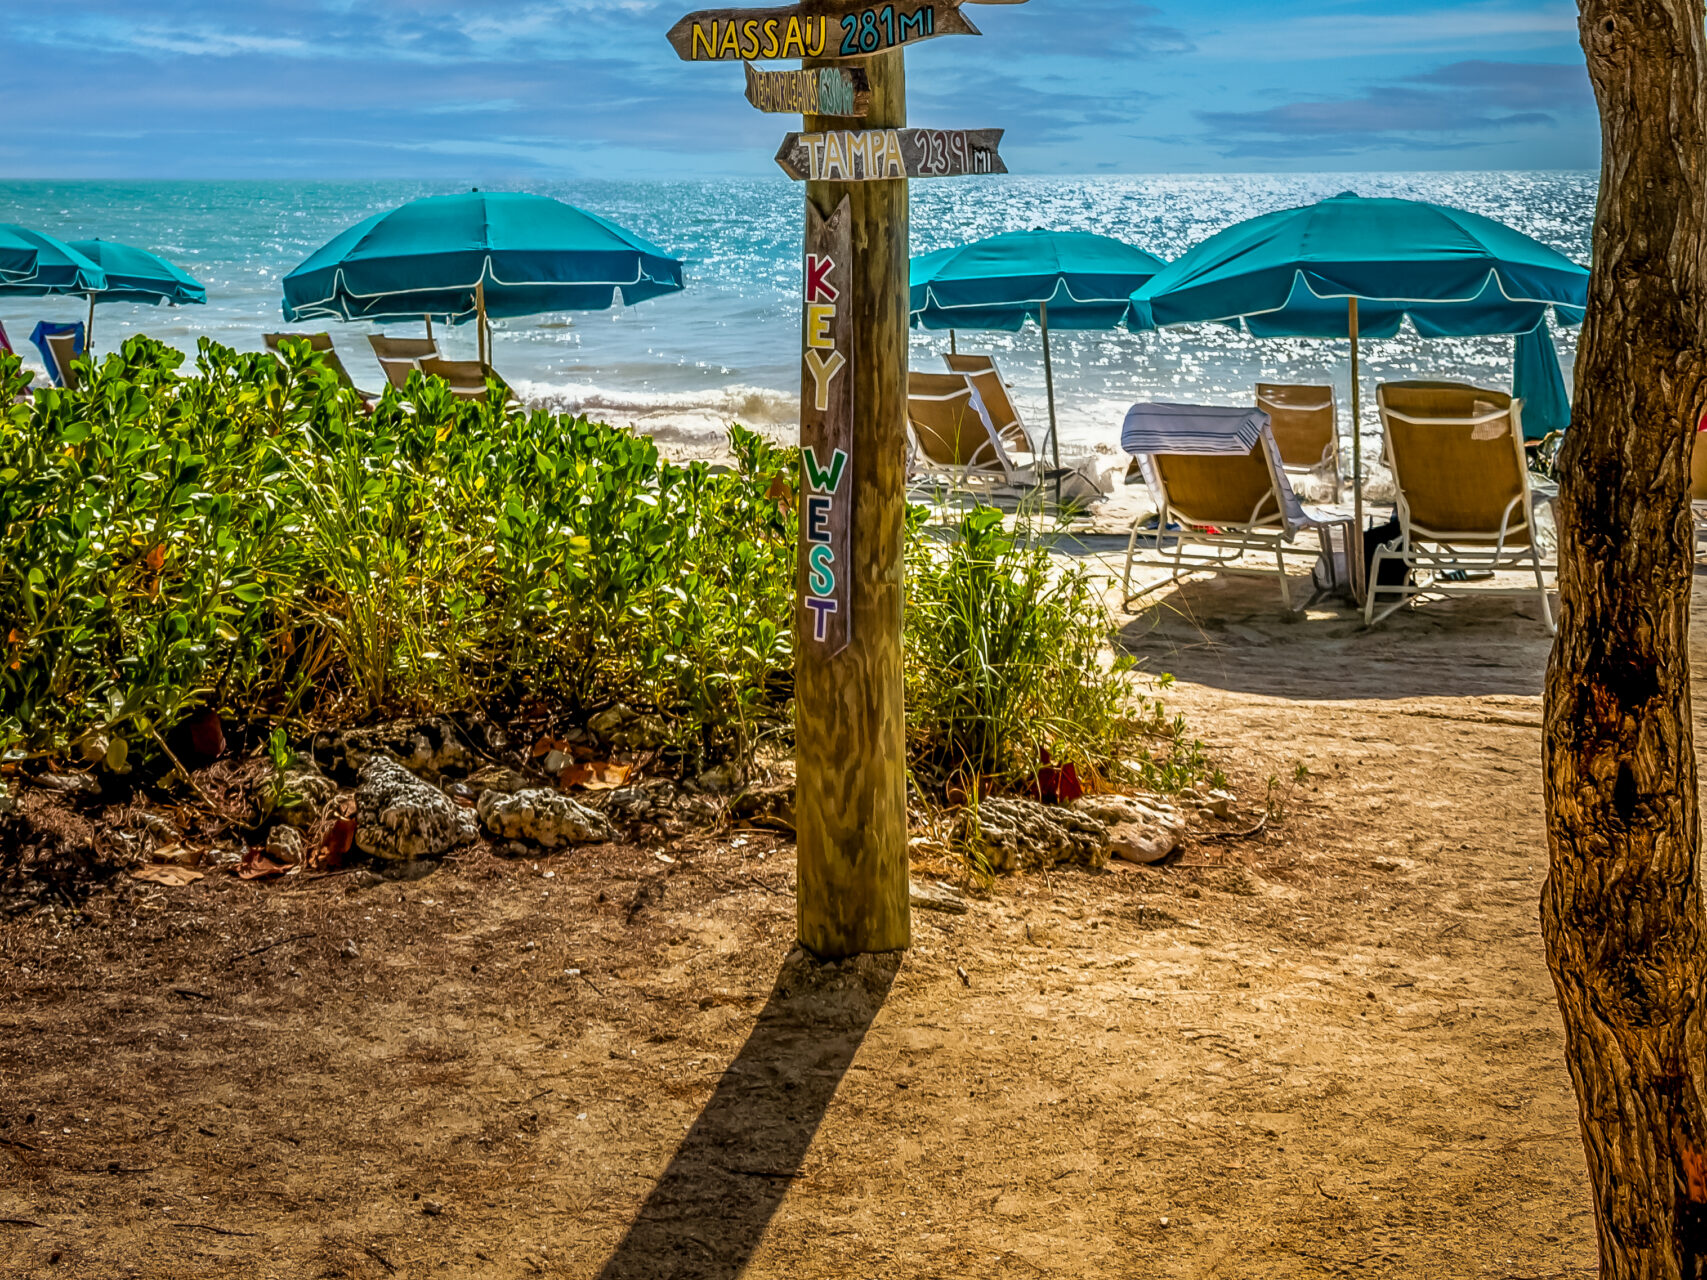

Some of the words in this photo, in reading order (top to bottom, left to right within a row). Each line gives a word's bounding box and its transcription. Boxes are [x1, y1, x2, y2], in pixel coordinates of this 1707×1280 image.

[691, 15, 828, 61] NASSAU
[839, 4, 896, 58] 281
[900, 5, 935, 42] MI
[799, 130, 907, 180] TAMPA
[914, 129, 970, 176] 239
[971, 145, 993, 174] MI
[804, 254, 847, 410] KEY
[801, 445, 849, 642] WEST
